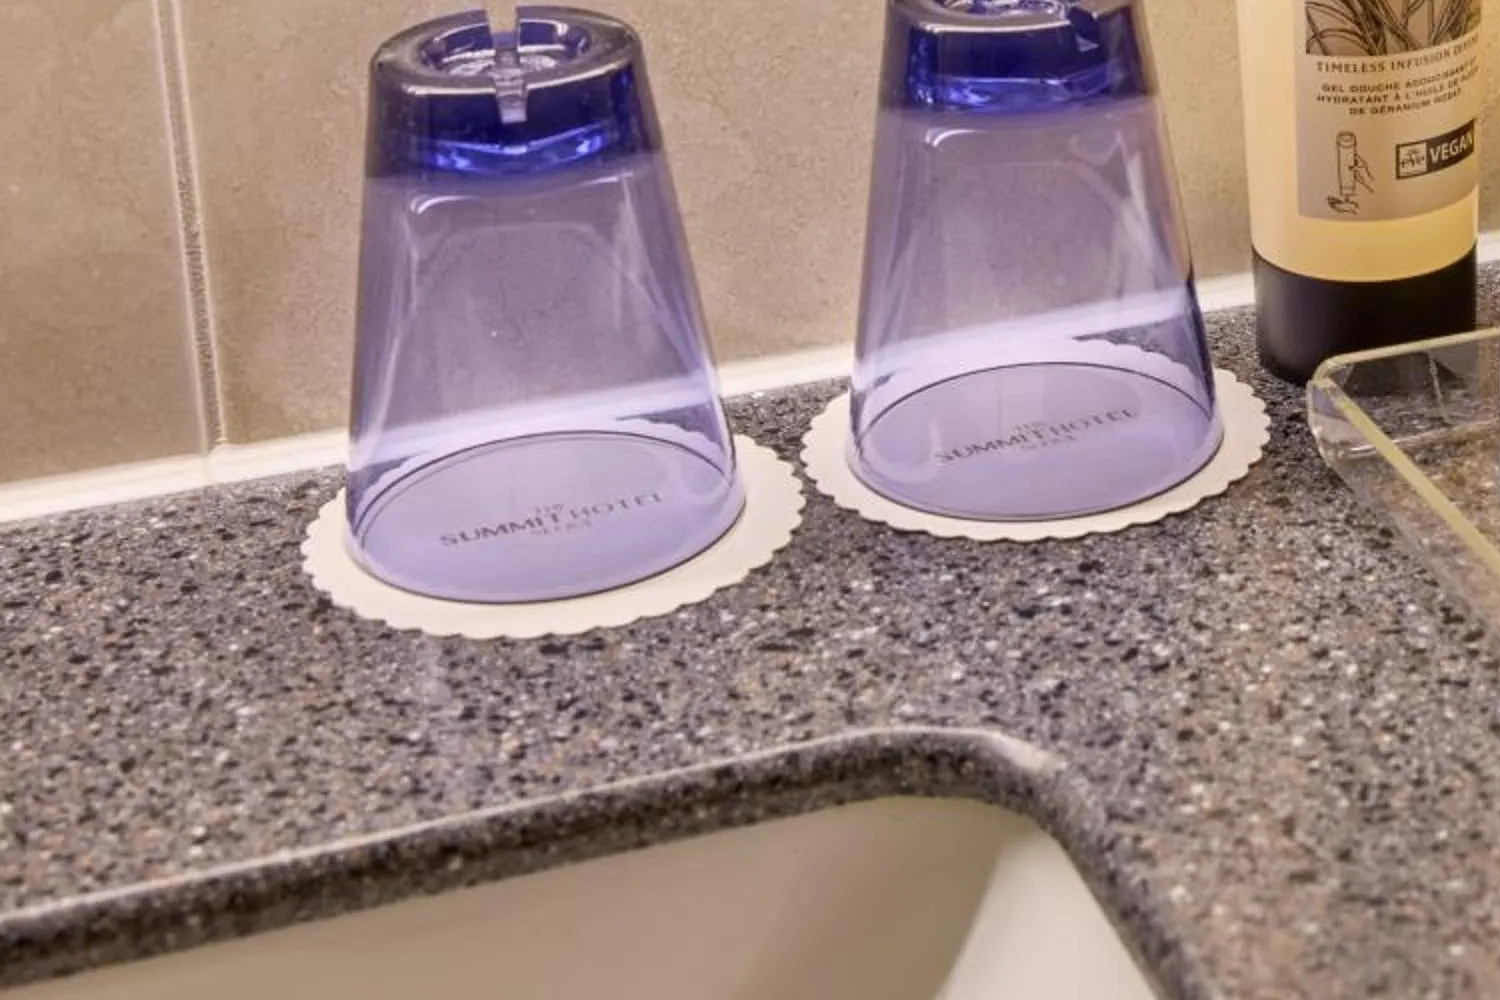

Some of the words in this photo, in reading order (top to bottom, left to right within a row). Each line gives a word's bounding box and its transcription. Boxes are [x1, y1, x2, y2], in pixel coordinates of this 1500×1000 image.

[1315, 60, 1386, 74] TIMELESS
[934, 430, 1045, 463] SUMMIT
[1048, 407, 1140, 436] HOTEL
[439, 512, 561, 547] SUMMIT
[569, 492, 662, 520] HOTEL
